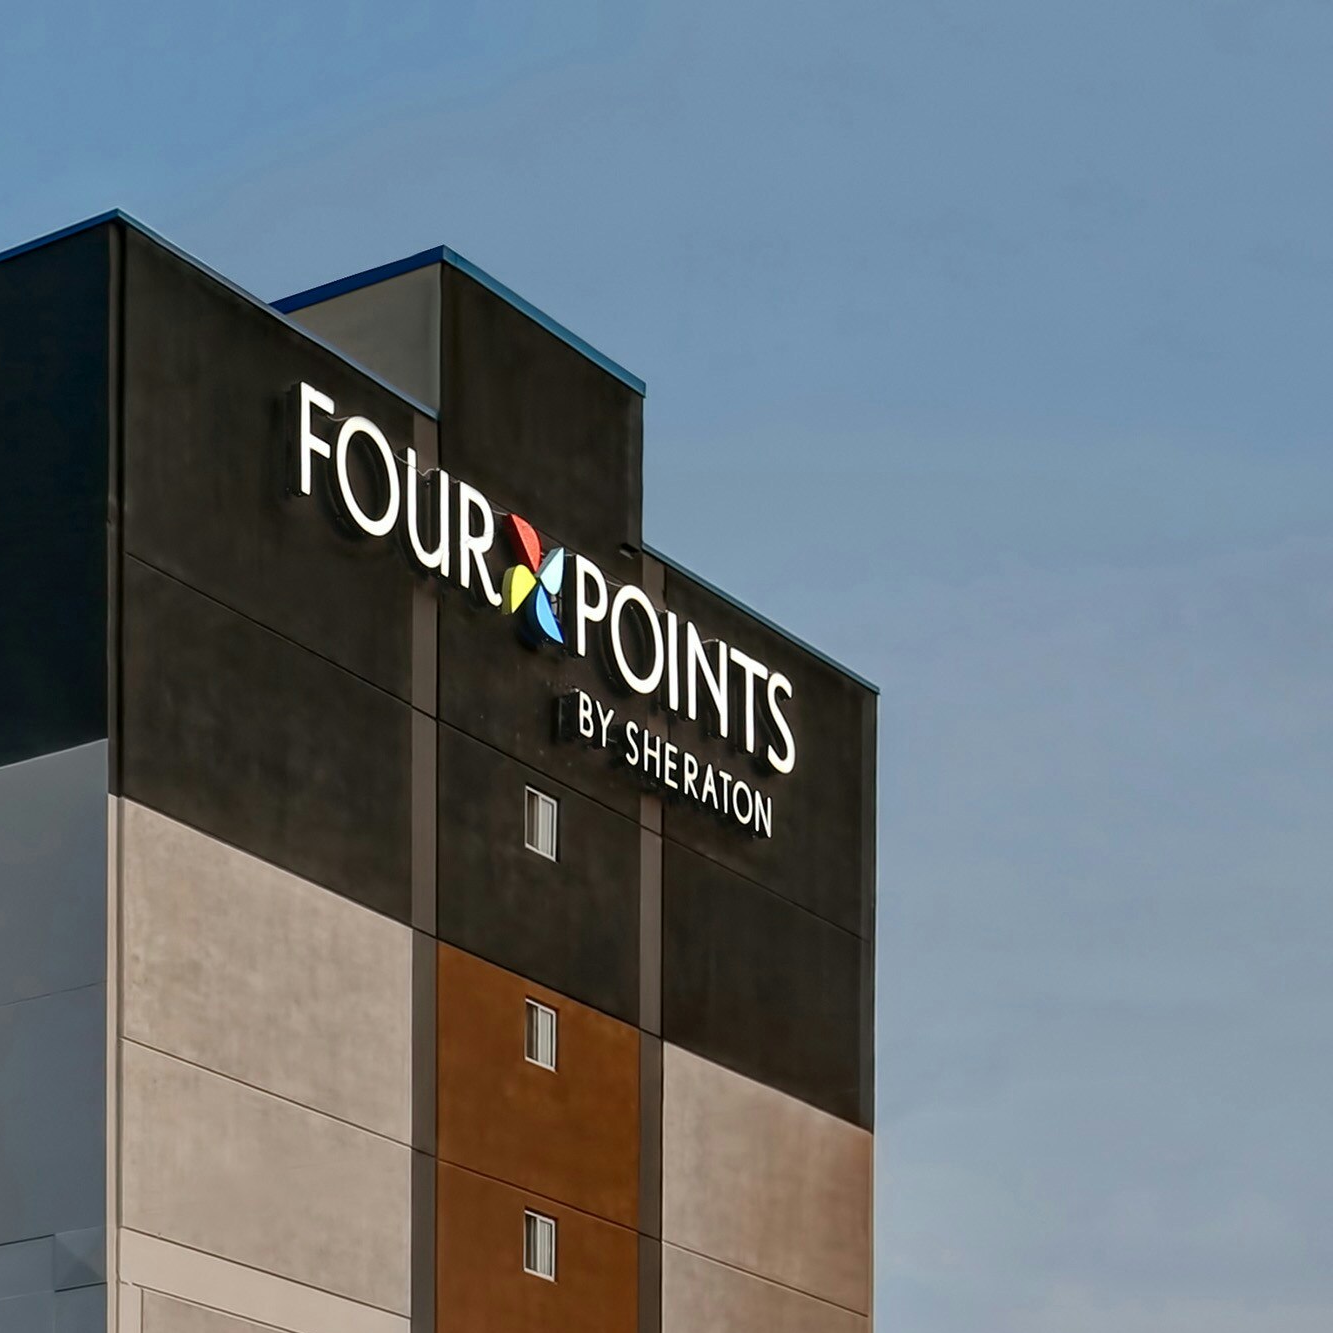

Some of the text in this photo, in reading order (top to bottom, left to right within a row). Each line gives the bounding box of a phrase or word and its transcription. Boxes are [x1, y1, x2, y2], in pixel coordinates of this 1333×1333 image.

[300, 381, 796, 774] FOUR POINTS
[578, 690, 773, 838] BY SHERATON
